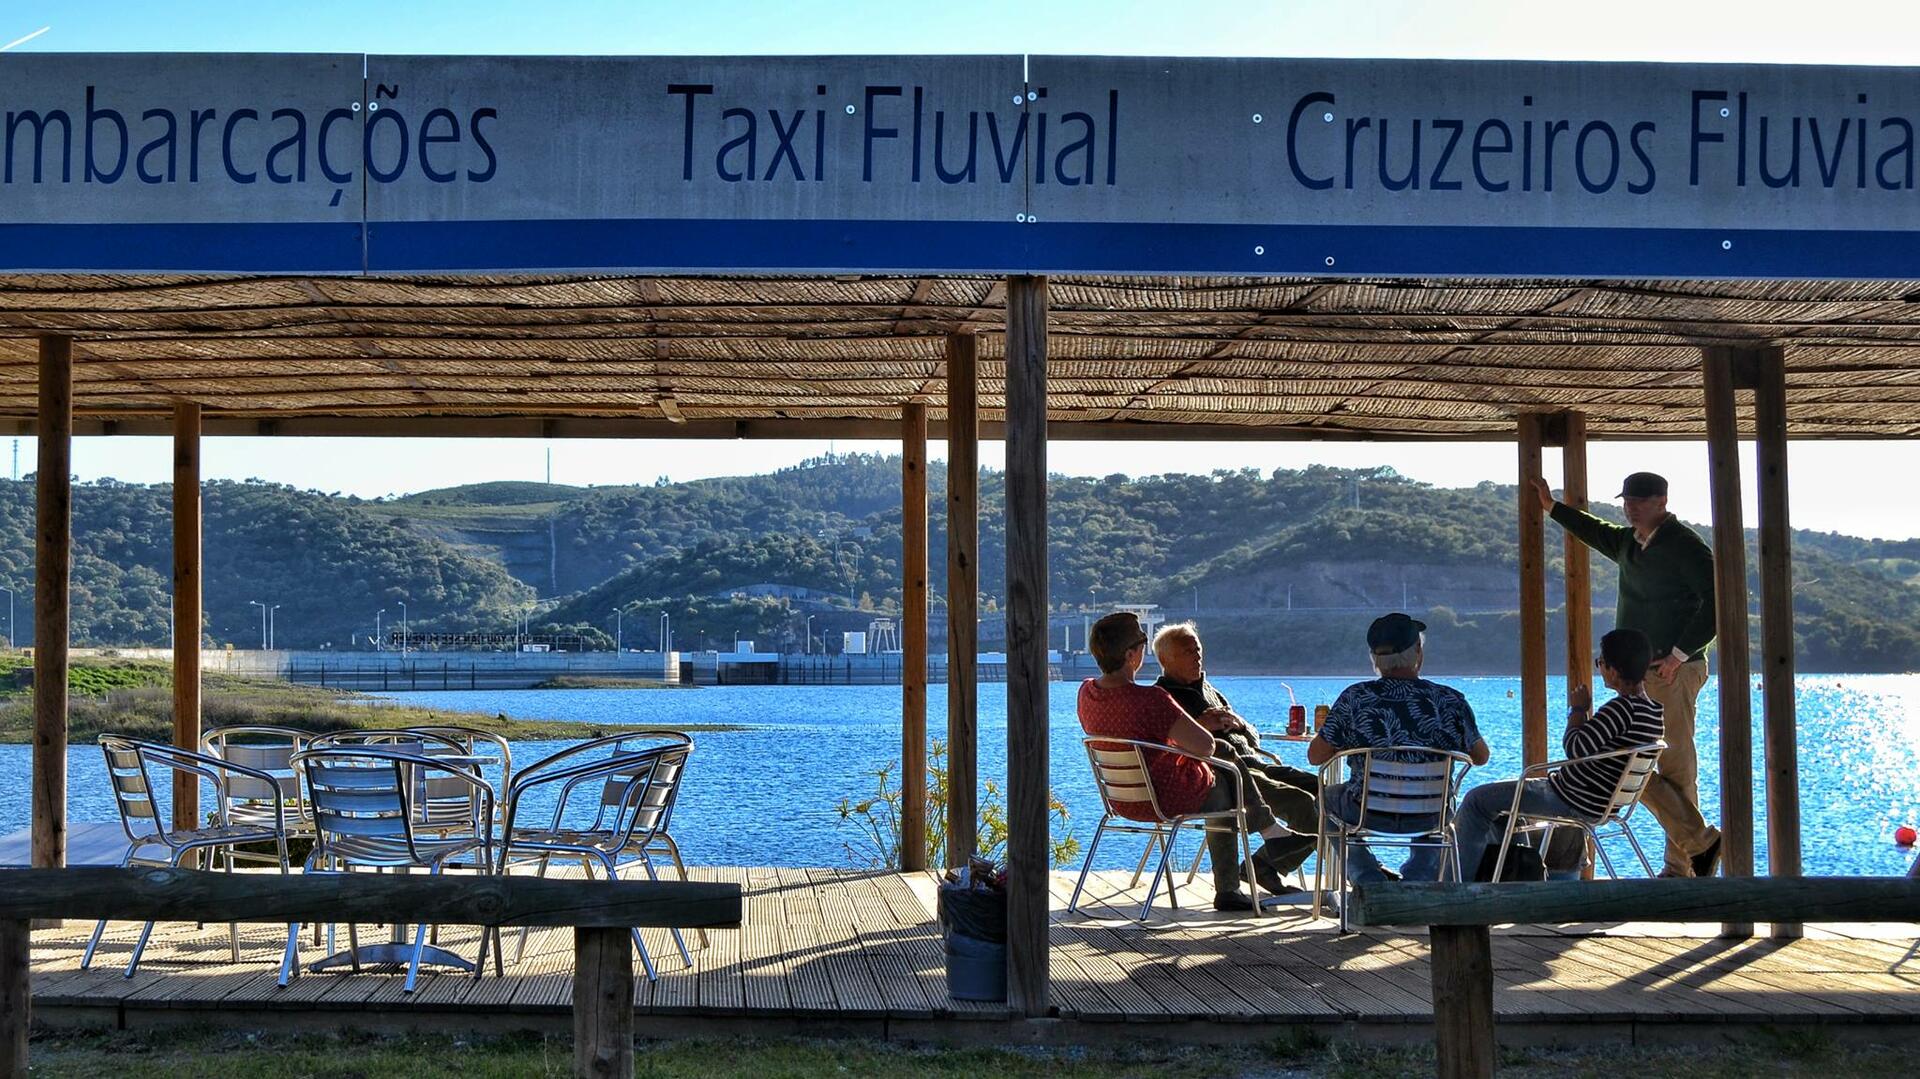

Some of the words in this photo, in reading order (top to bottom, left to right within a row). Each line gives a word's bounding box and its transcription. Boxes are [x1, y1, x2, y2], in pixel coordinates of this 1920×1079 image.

[3, 85, 498, 207] mbarcações
[667, 84, 827, 182] Taxi
[862, 86, 1119, 186] Fluvial
[1286, 92, 1656, 195] Cruzeiros
[1689, 90, 1915, 190] Fluvia
